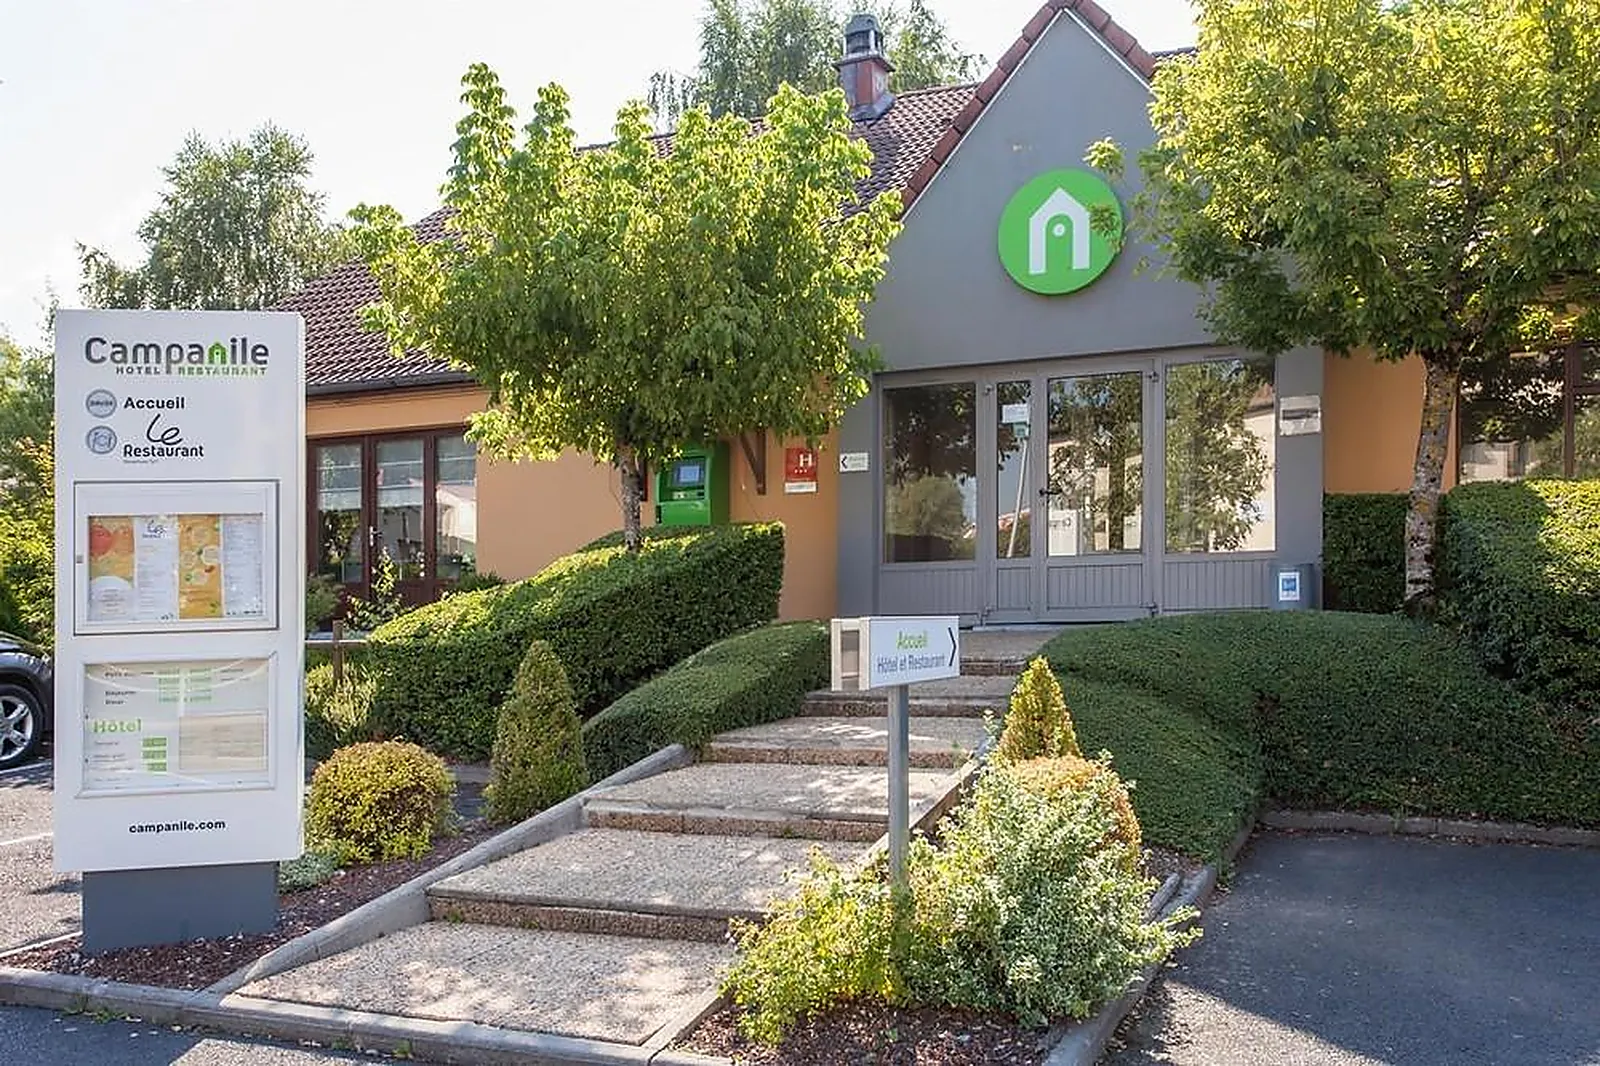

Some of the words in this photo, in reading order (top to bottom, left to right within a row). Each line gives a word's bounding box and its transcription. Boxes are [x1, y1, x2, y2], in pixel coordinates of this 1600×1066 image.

[85, 337, 269, 374] Campanile
[178, 366, 267, 375] RESTAURANT
[123, 397, 185, 409] Accueil
[146, 413, 183, 445] Le
[123, 444, 204, 457] Restaurant
[799, 453, 813, 467] H
[896, 630, 927, 649] Accueil
[908, 654, 945, 670] Restaurant
[129, 820, 226, 833] campanile.com
